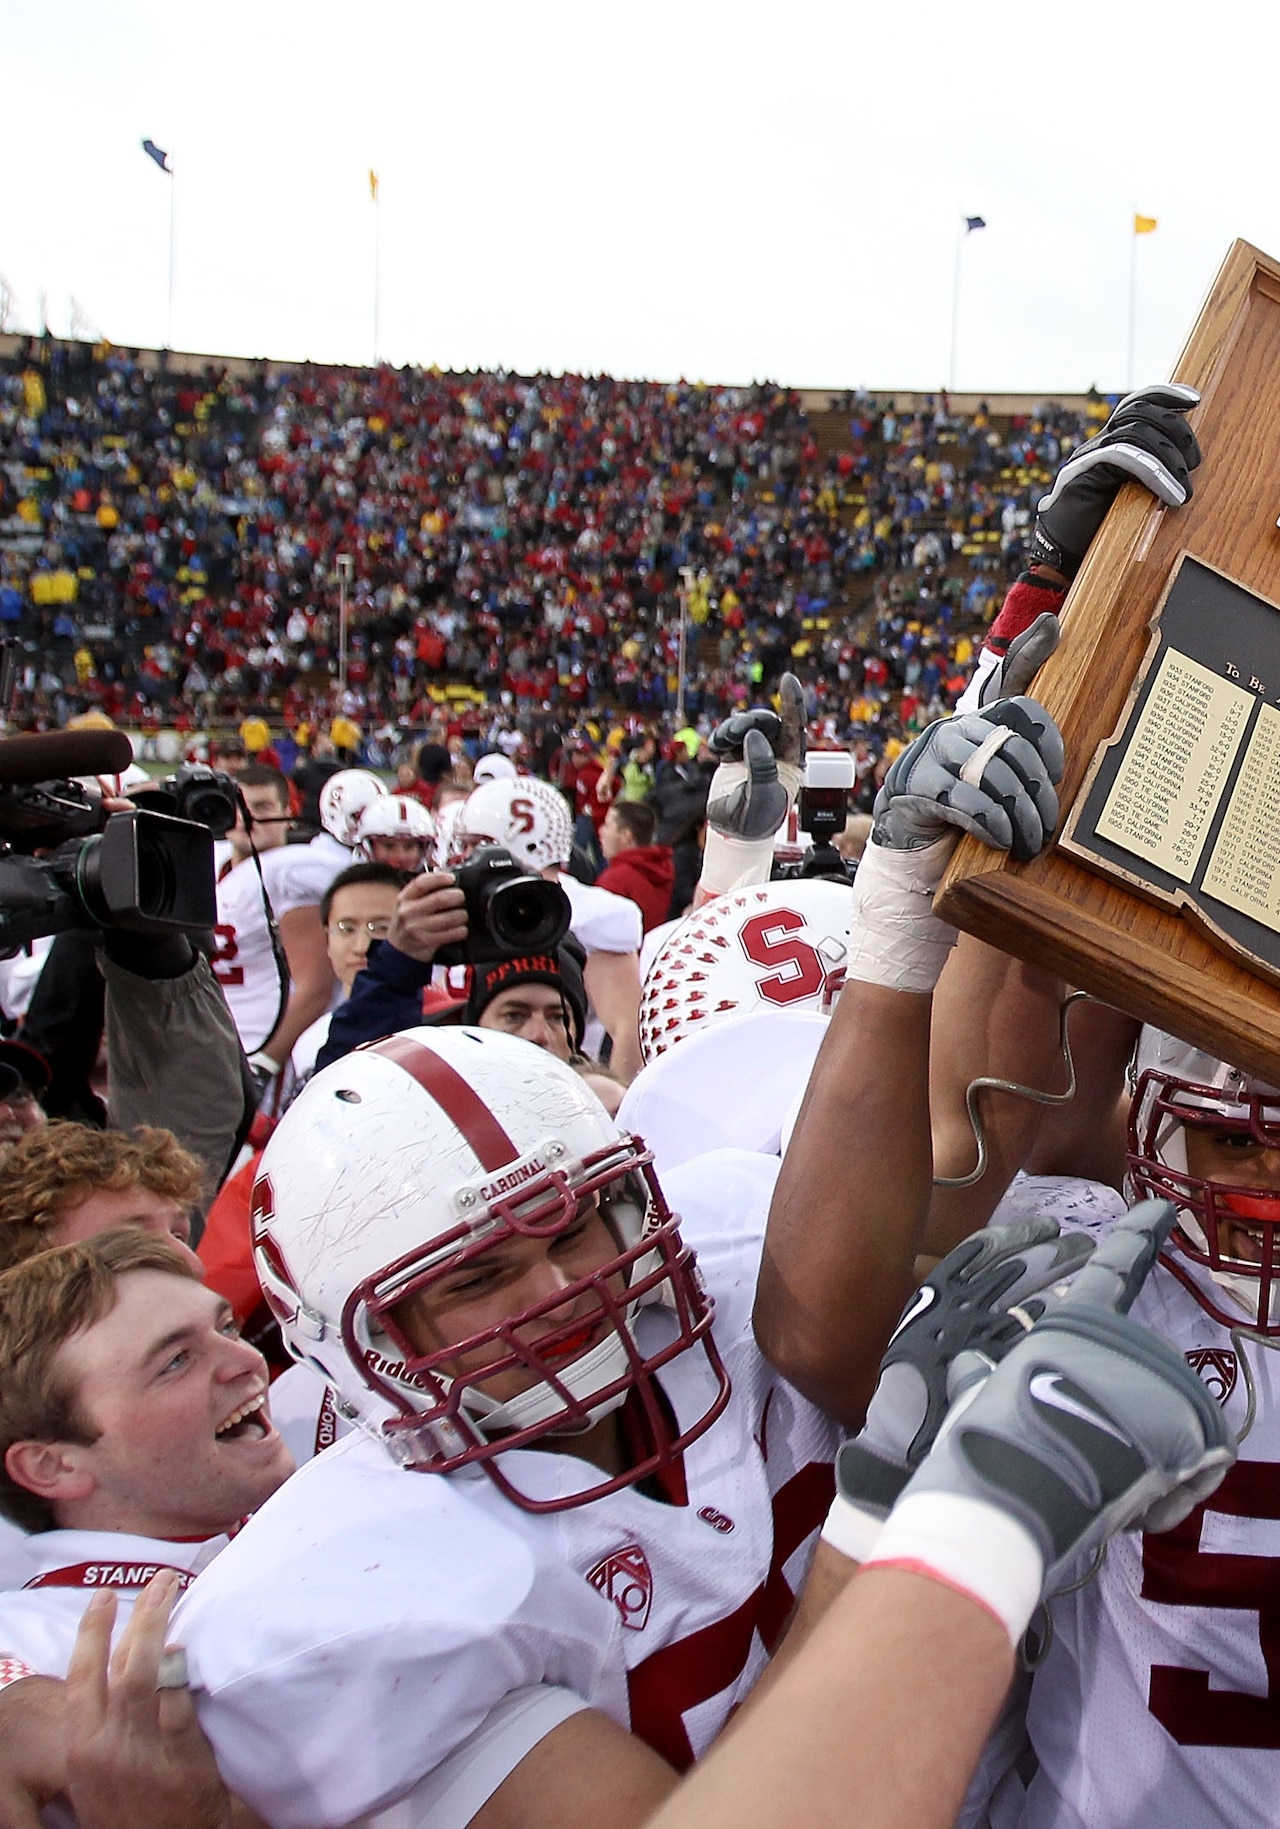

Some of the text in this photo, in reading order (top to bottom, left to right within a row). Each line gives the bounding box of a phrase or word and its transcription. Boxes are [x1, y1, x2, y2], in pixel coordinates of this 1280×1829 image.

[1182, 671, 1215, 694] STANFORD
[1170, 702, 1206, 727] CALIFORNIA
[1148, 758, 1186, 783] CALIFORNIA
[1142, 775, 1179, 801] CALIFORNIA
[1133, 790, 1170, 816] CALIFORNIA
[1123, 826, 1157, 850] STANFORD
[1126, 817, 1164, 843] CALIFORNIA
[1246, 831, 1280, 856] STANFORD
[1237, 857, 1273, 882] CALIFORNIA
[1240, 848, 1276, 873] STANFORD
[1232, 874, 1268, 899] STANFORD
[1235, 866, 1271, 890] STANFORD
[1229, 883, 1270, 911] CALIFORNIA
[737, 906, 828, 1008] S
[480, 1158, 545, 1201] CARDINAL
[696, 1504, 735, 1534] S
